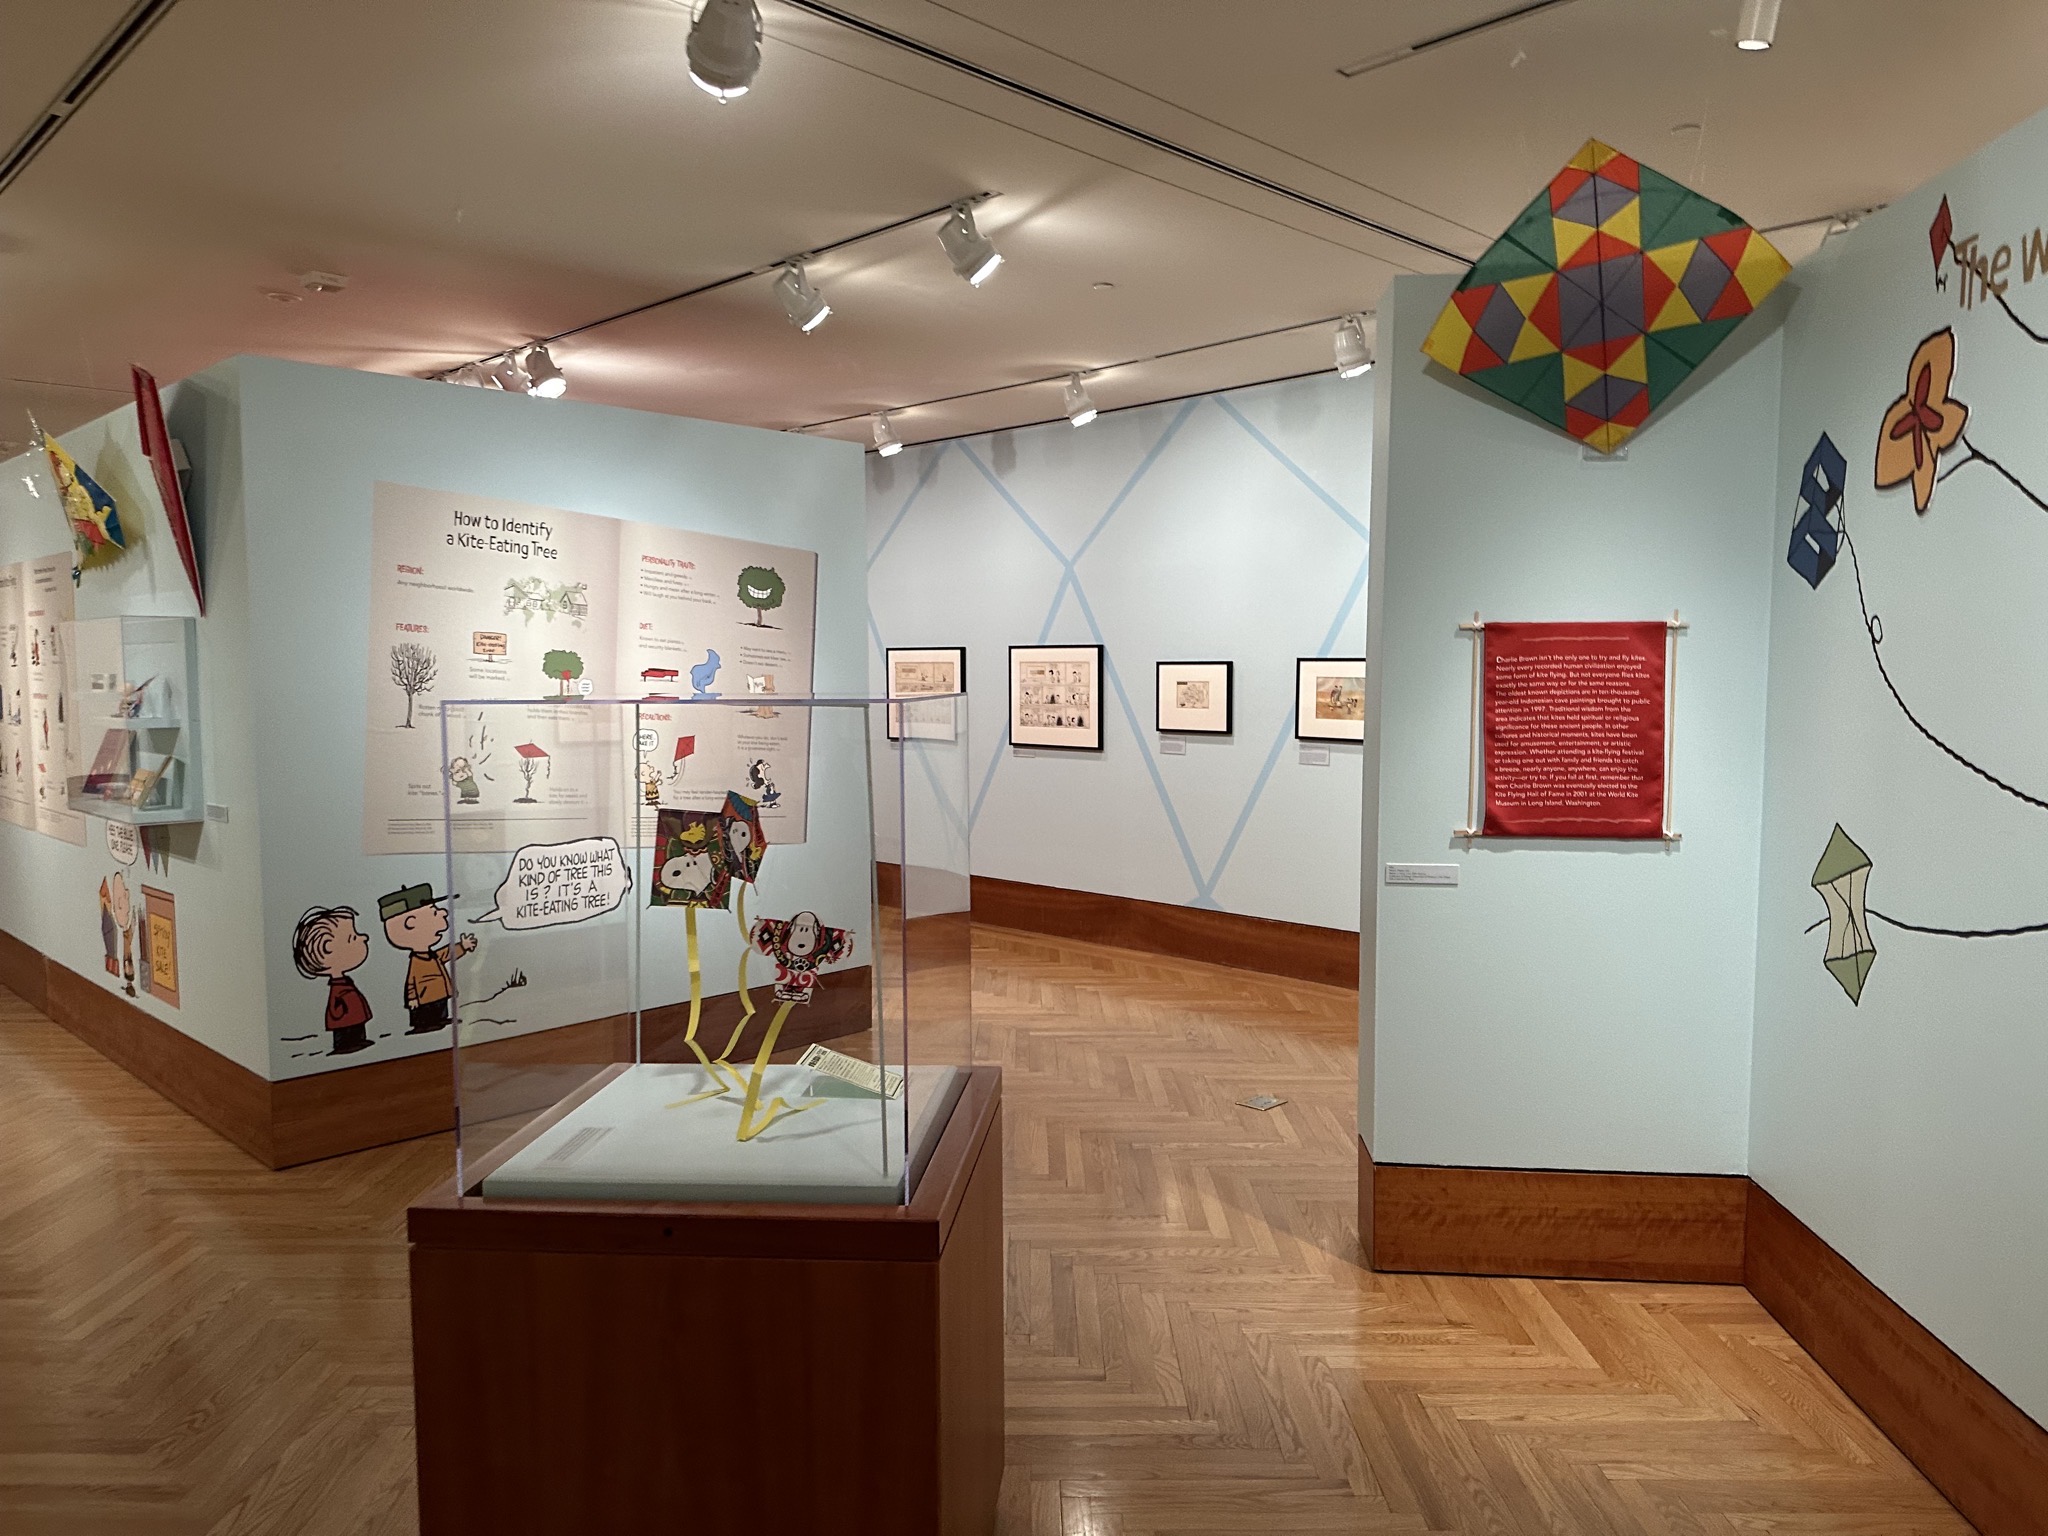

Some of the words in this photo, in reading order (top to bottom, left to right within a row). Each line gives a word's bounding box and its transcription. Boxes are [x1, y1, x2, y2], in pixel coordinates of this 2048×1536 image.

[1954, 233, 2012, 311] The
[454, 510, 481, 529] How
[484, 515, 499, 531] to
[502, 518, 553, 541] Identify
[446, 533, 455, 546] a
[458, 532, 529, 560] Kite-Eating
[531, 541, 558, 560] Tree
[1496, 665, 1515, 673] Nearly
[1550, 688, 1580, 696] depictions
[1597, 697, 1622, 705] brought
[1581, 714, 1604, 722] spiritual
[519, 858, 534, 872] DO
[537, 855, 557, 870] YOU
[560, 851, 587, 866] KNOW
[590, 848, 615, 864] WHAT
[519, 871, 545, 888] KIND
[548, 869, 561, 884] OF
[564, 866, 588, 881] TREE
[590, 863, 612, 878] THIS
[558, 882, 581, 897] IT'S
[588, 880, 598, 893] A
[516, 898, 579, 919] KITE-EATING
[581, 892, 610, 909] TREE!
